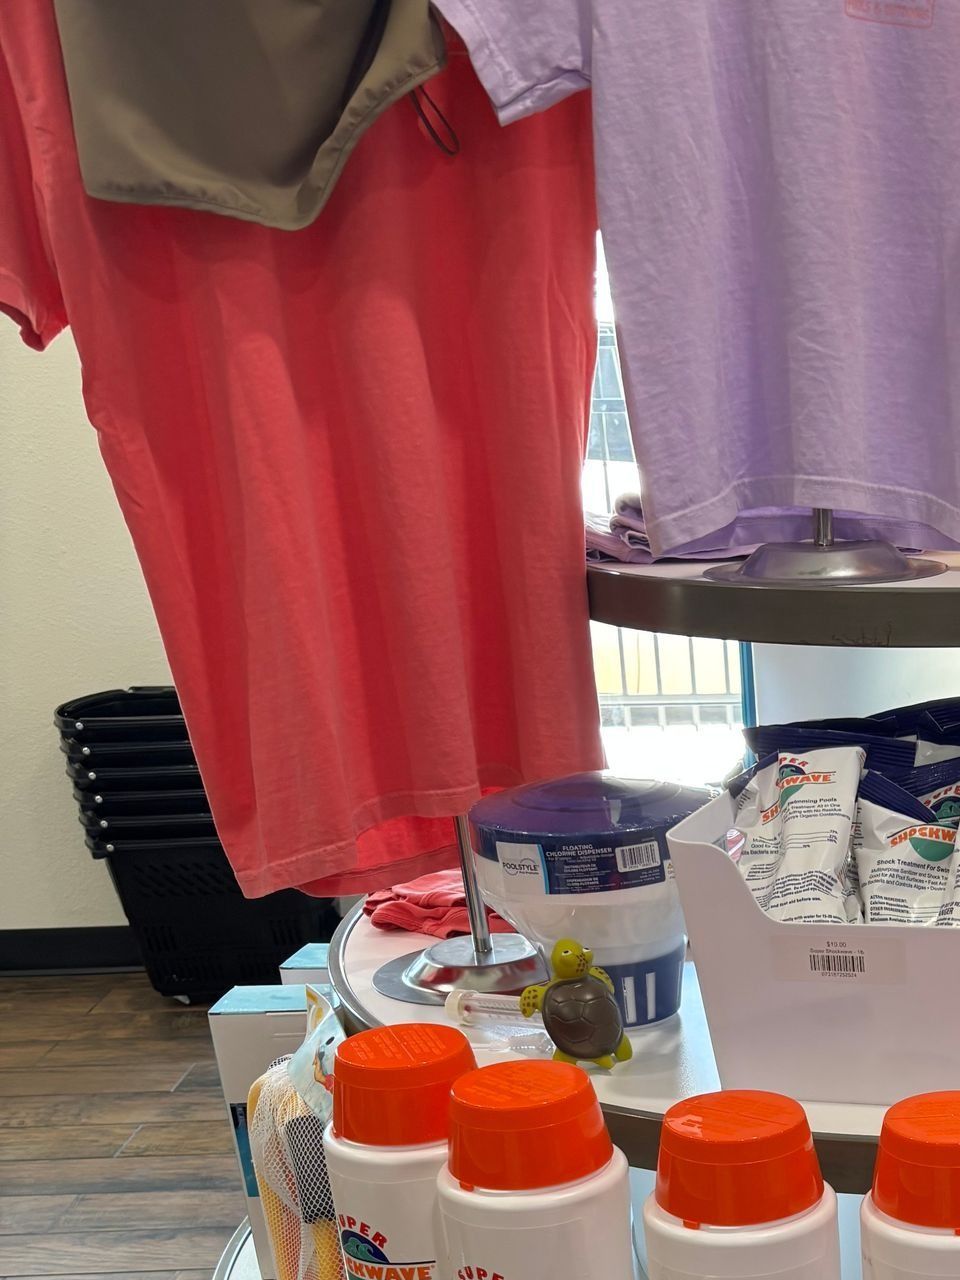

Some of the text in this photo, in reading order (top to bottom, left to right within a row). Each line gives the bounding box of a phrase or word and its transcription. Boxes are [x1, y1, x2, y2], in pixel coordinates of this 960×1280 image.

[779, 757, 809, 767] PER
[890, 827, 956, 848] SHOCKW
[577, 848, 612, 856] DISPENSER
[503, 862, 537, 872] POOLSTYLE
[898, 859, 926, 869] Treatment
[338, 1214, 388, 1249] UPER
